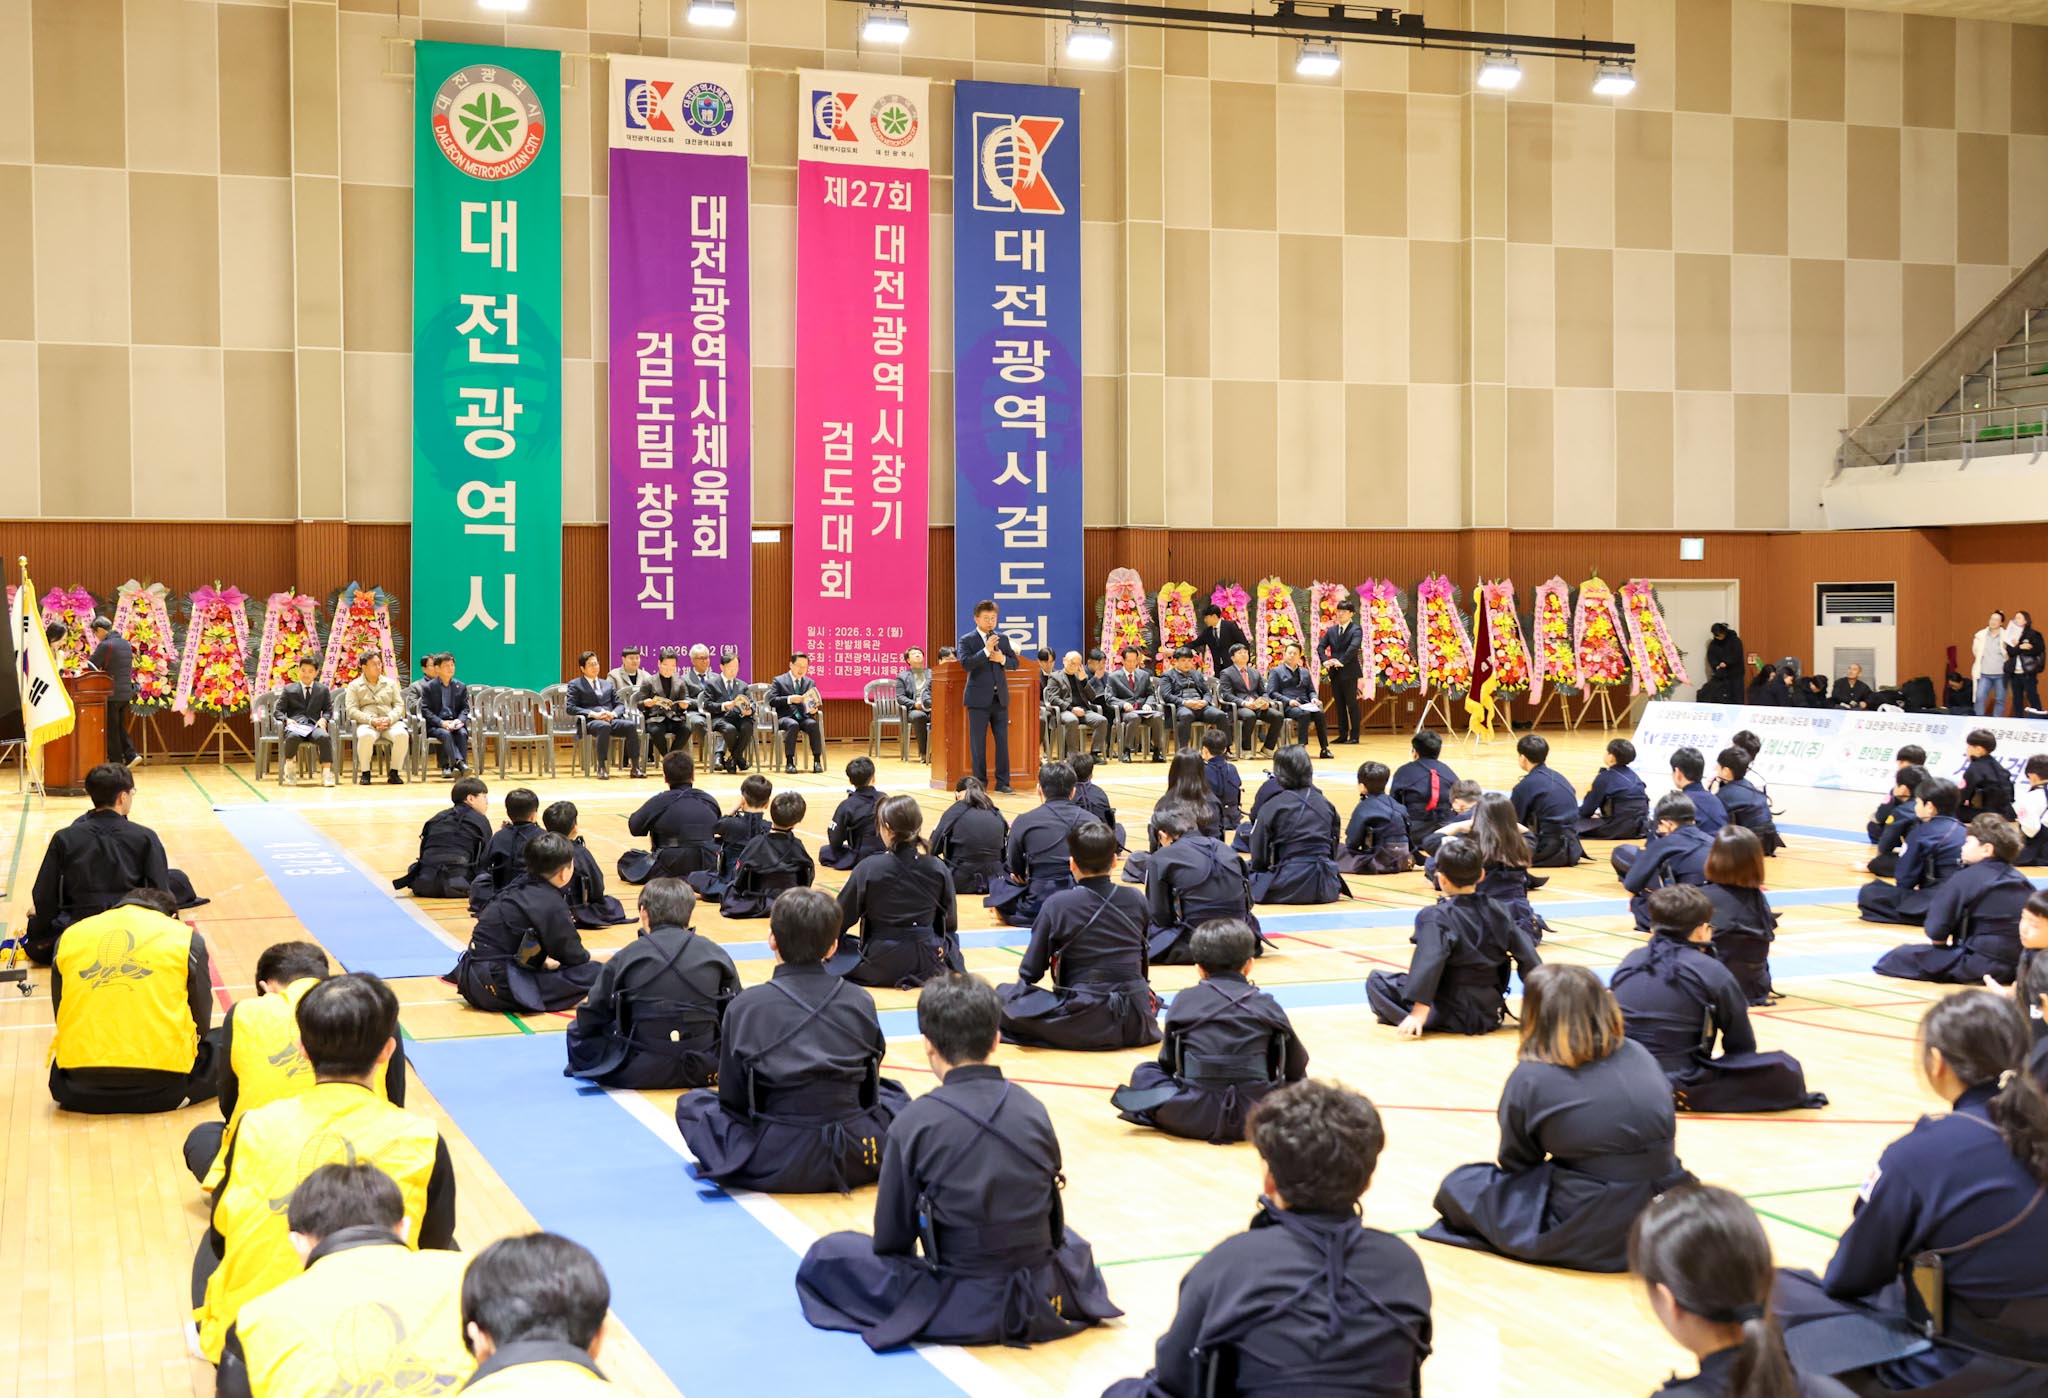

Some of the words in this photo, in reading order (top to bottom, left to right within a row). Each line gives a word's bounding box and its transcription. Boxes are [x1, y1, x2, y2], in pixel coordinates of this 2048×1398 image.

[436, 68, 541, 118] 대전광역시
[434, 124, 466, 168] DAEJEON
[463, 153, 531, 179] METROPOLITAN
[523, 132, 541, 156] CITY
[823, 175, 912, 213] 제27회
[636, 331, 676, 470] 검도팀
[690, 195, 729, 559] 대전광역시체육회
[871, 224, 908, 540] 대전광역시장기
[452, 200, 523, 644] 대전광역시
[819, 420, 856, 601] 검도대회
[636, 482, 679, 621] 창단식
[806, 626, 826, 638] 일시
[834, 626, 863, 637] 2026.
[865, 627, 876, 637] 3.
[877, 627, 885, 637] 2
[886, 626, 904, 638] (월)
[806, 639, 825, 650] 장소
[834, 639, 881, 651] 한밭체육관
[808, 652, 825, 663] 주최
[807, 666, 825, 676] 후원
